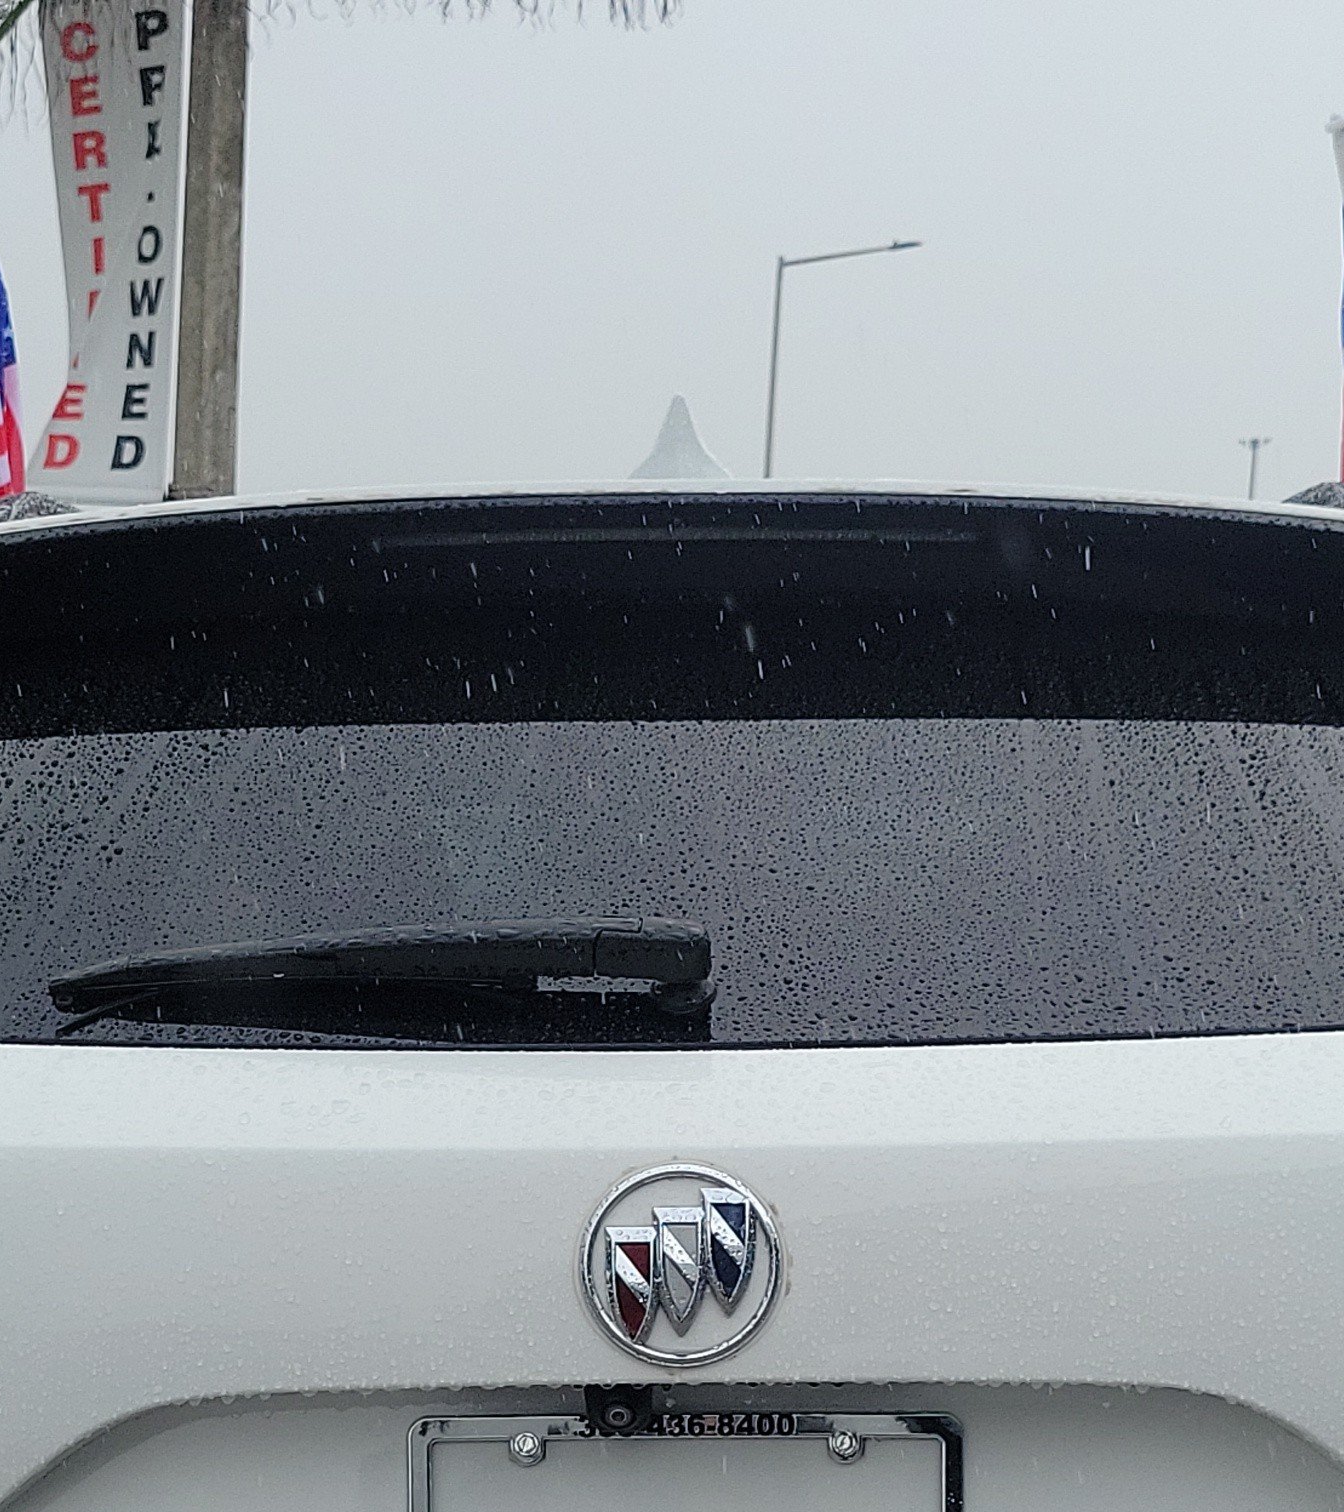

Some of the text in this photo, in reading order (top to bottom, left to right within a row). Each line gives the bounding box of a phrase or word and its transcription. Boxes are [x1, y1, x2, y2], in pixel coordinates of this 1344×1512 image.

[42, 22, 111, 470] CERTIED
[110, 9, 170, 470] PROWNED
[578, 1414, 796, 1437] 3436-8400
